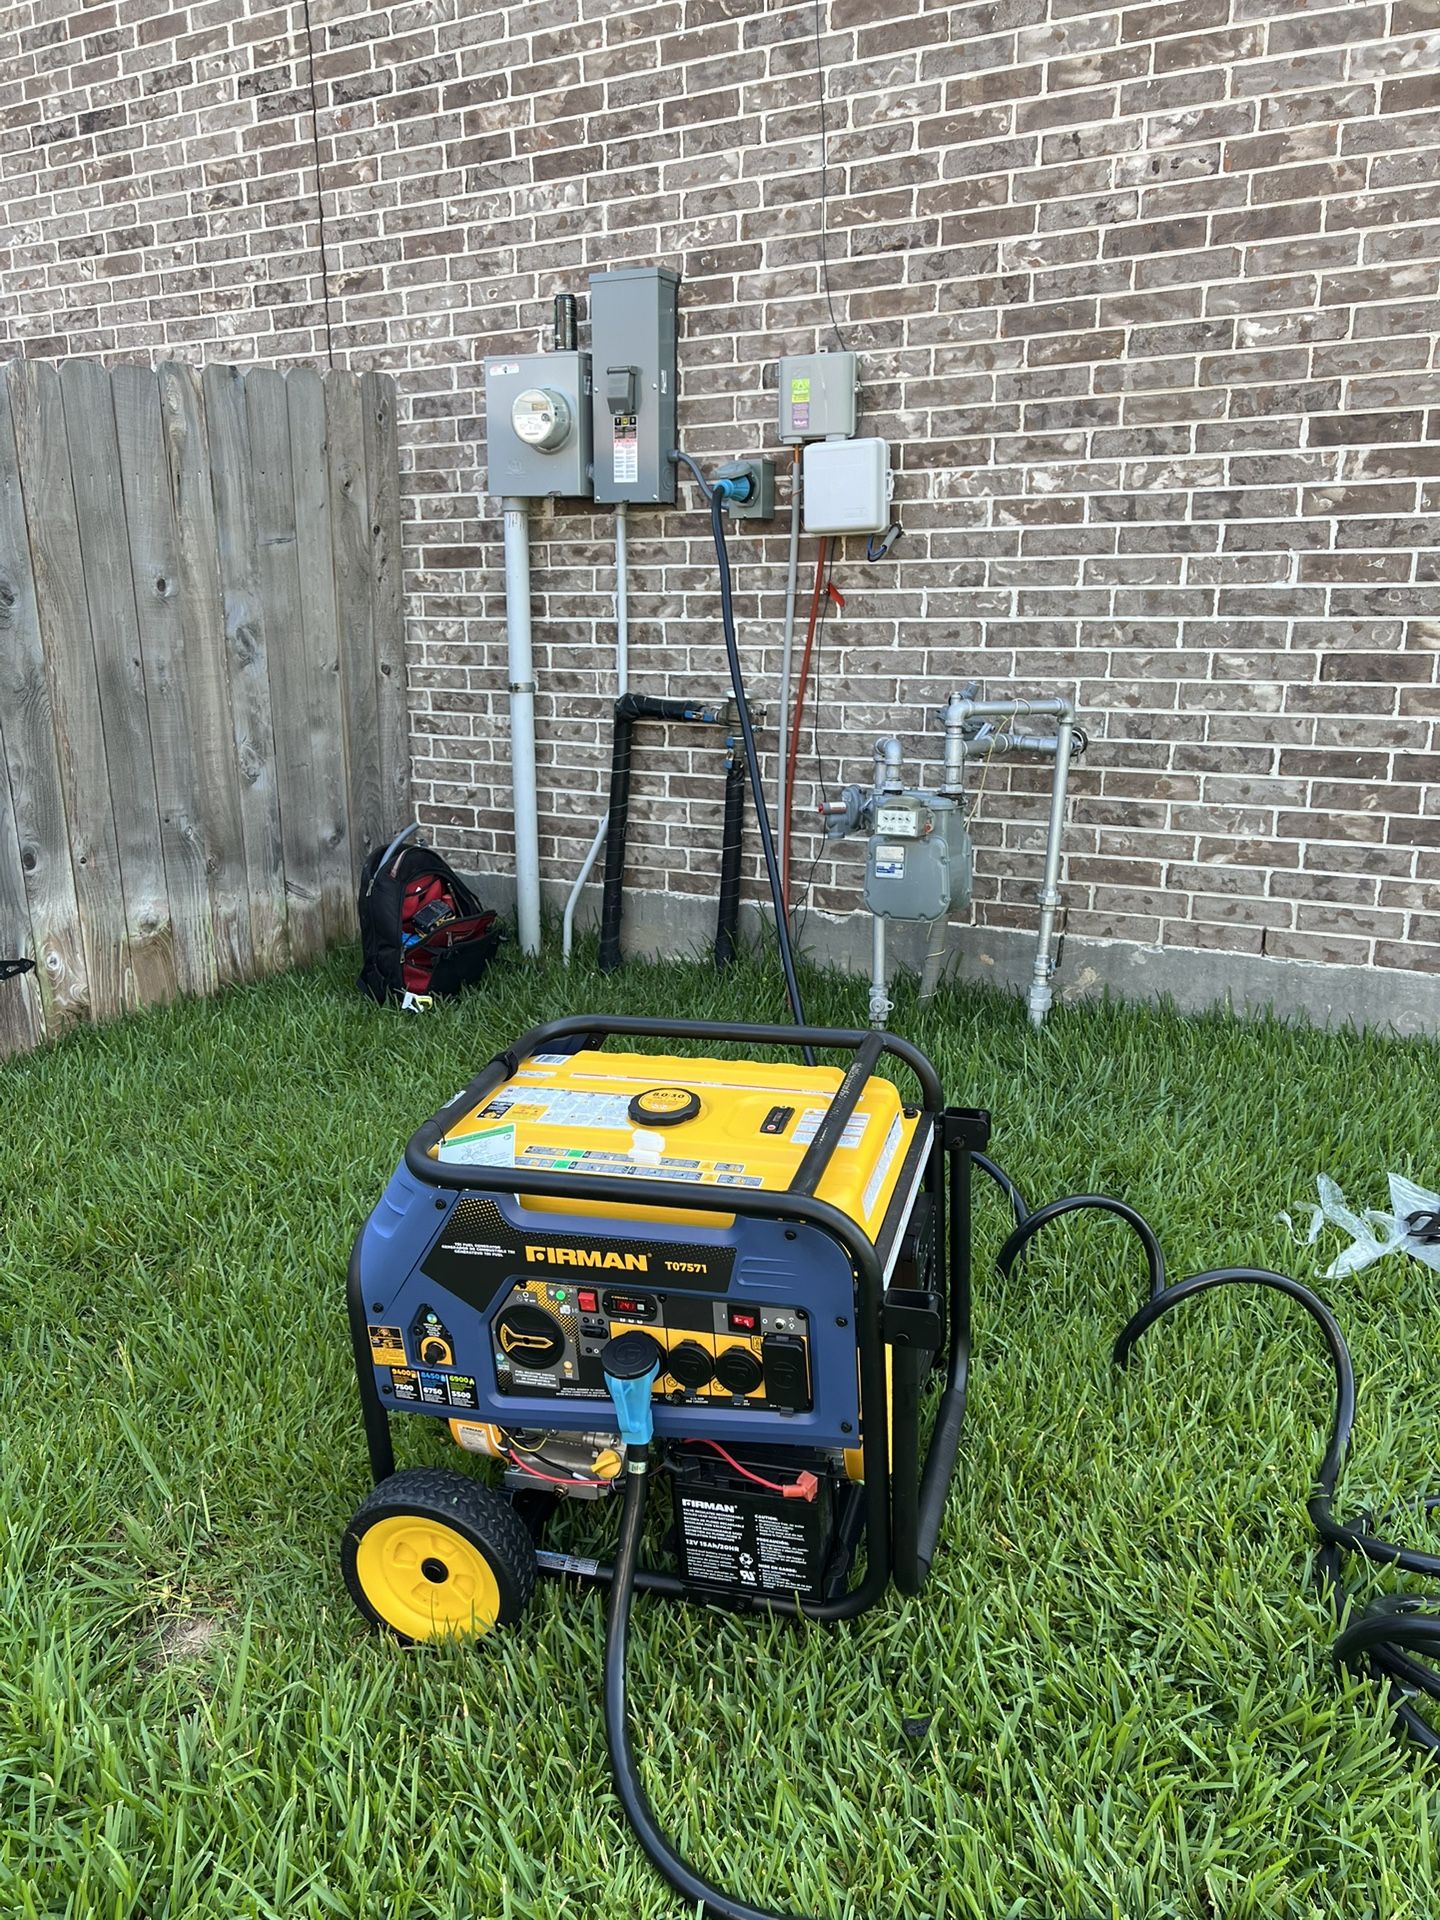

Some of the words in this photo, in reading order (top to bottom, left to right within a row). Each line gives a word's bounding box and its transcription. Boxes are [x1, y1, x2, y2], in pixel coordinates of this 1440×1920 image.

[525, 1245, 648, 1271] FIRMAN
[664, 1261, 707, 1274] T07571
[391, 1368, 411, 1376] 9400
[449, 1375, 468, 1383] 6900
[423, 1387, 442, 1395] 6750
[682, 1498, 735, 1513] FIRMAN
[686, 1538, 698, 1546] 12V
